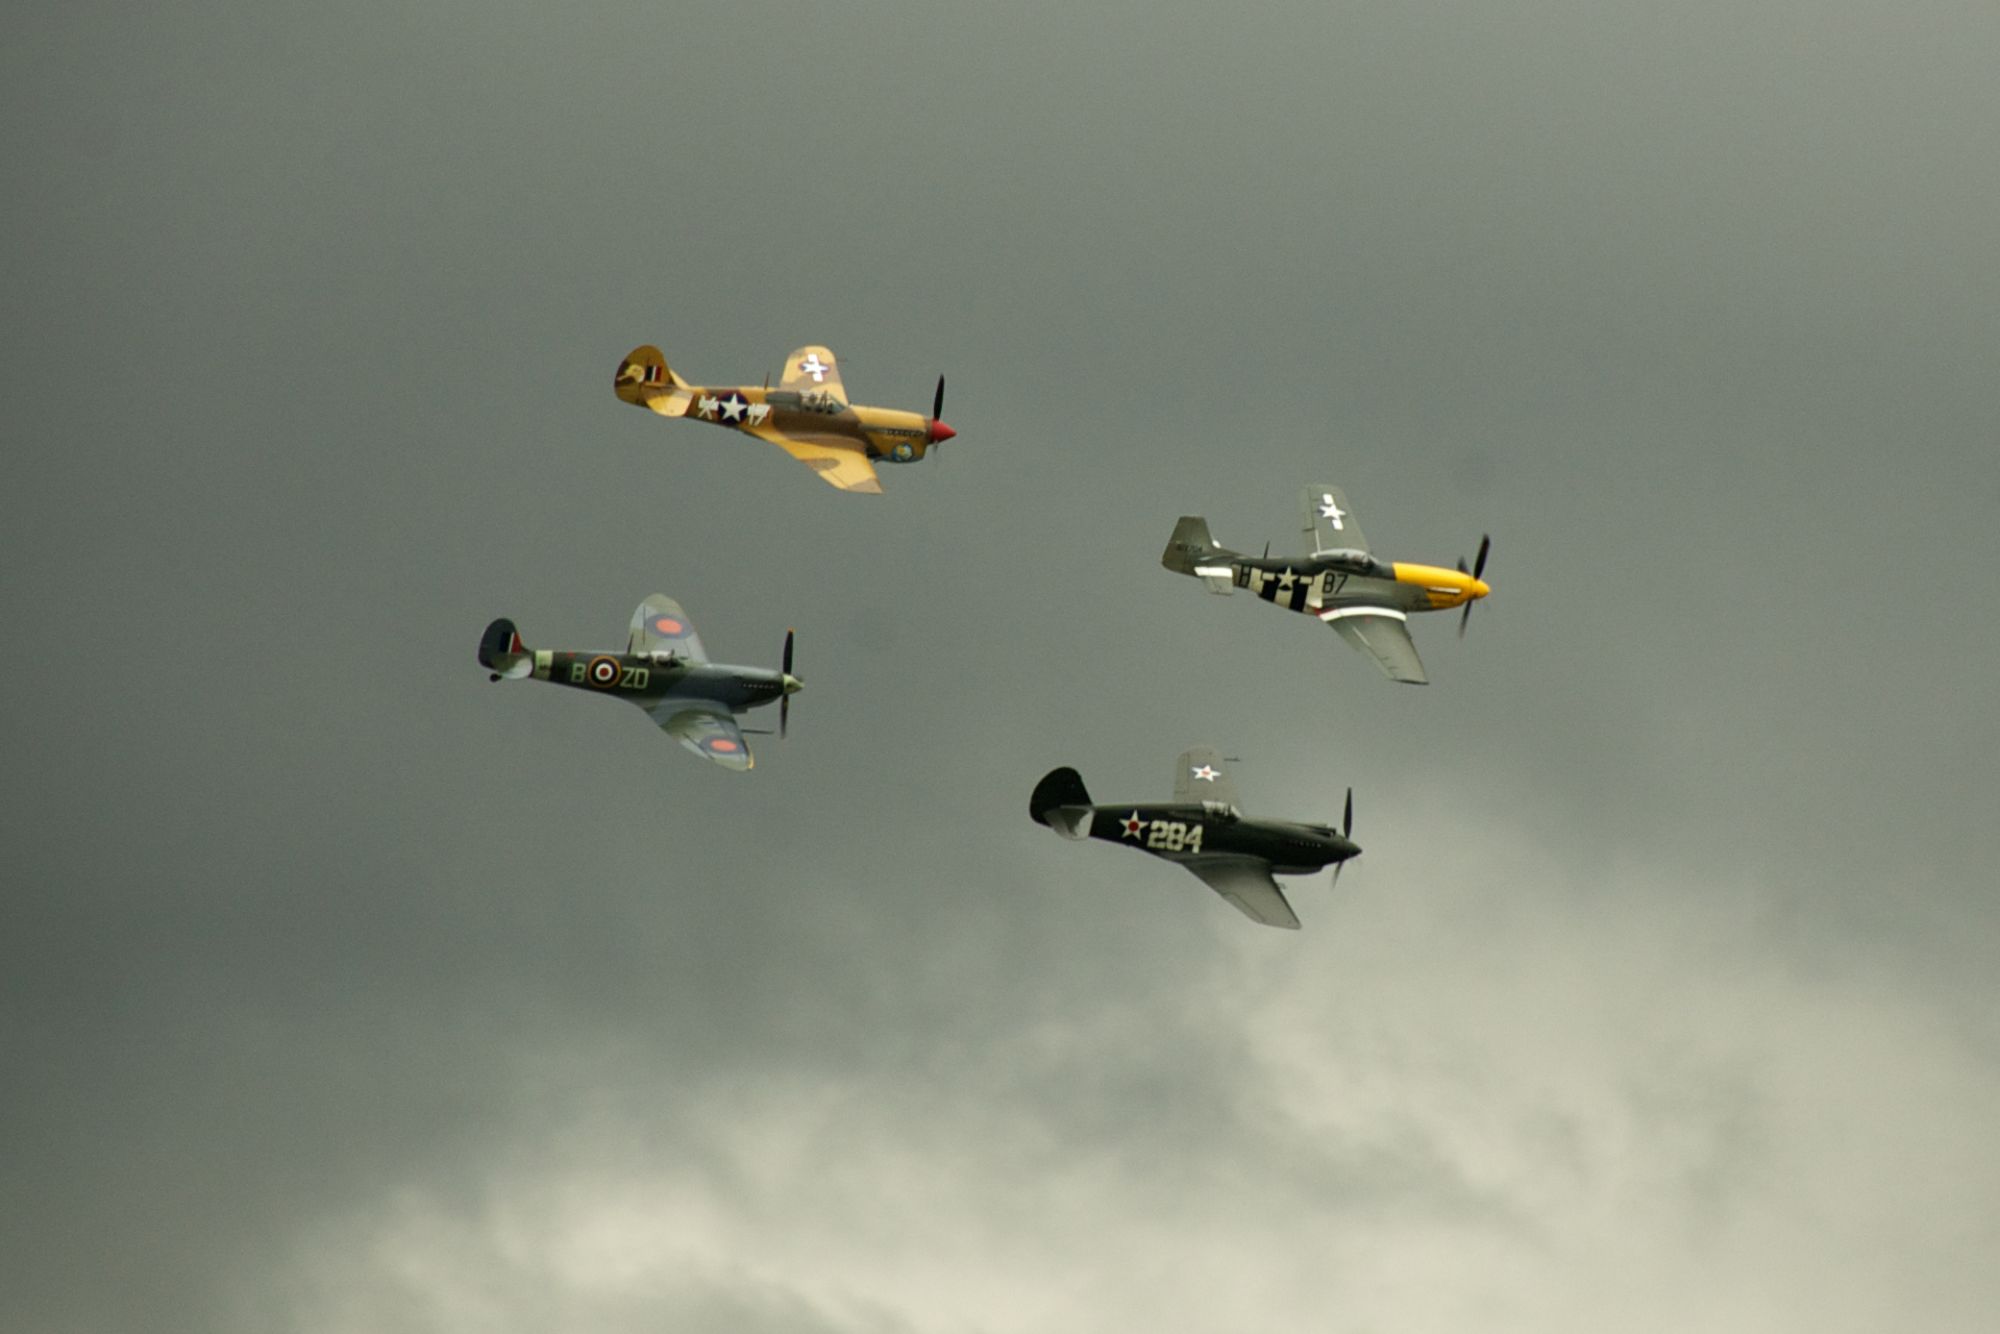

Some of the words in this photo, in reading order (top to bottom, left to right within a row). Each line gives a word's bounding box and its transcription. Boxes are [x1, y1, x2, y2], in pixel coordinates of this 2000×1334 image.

[571, 662, 587, 683] B
[620, 666, 650, 689] ZD
[1147, 819, 1203, 854] 284
